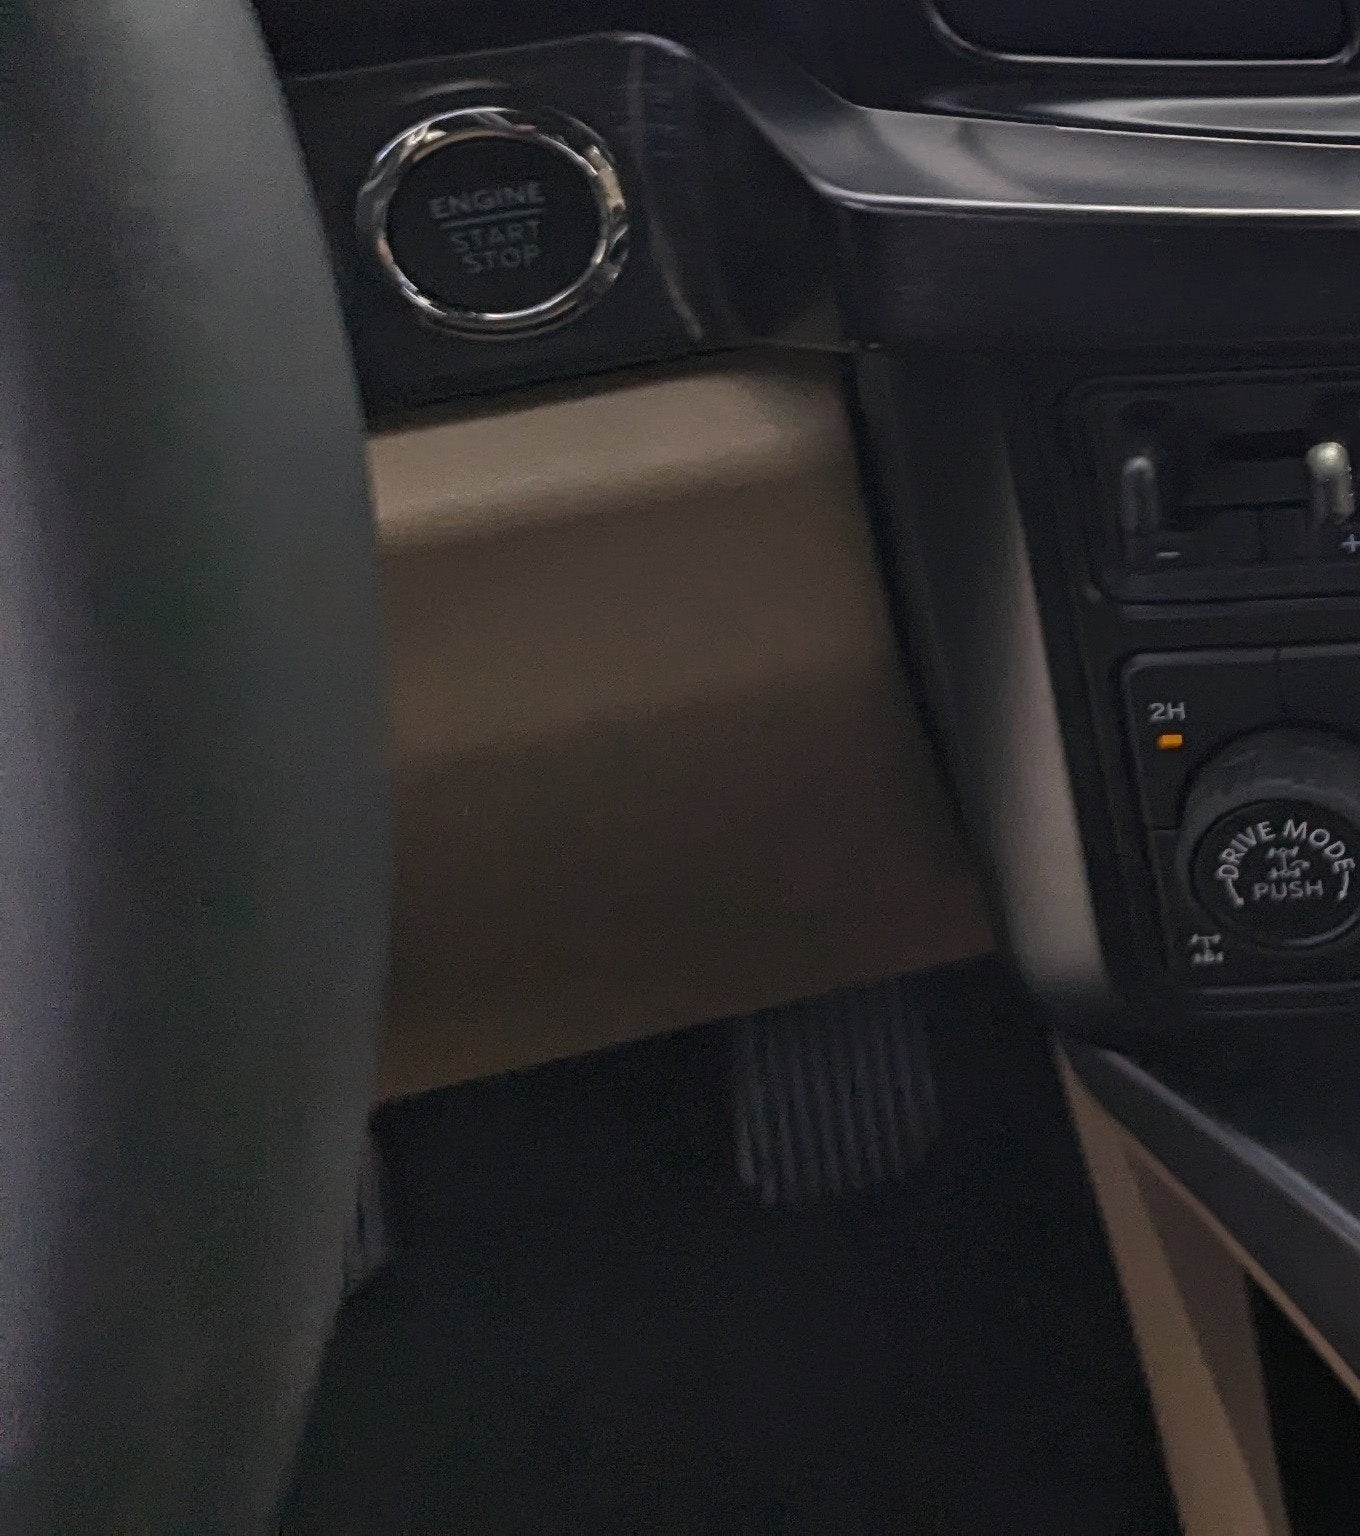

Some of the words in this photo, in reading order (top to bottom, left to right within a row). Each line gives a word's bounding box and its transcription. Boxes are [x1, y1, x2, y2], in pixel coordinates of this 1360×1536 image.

[428, 182, 545, 219] ENGINE
[450, 220, 541, 252] START
[462, 244, 540, 274] STOP
[1149, 702, 1186, 722] 2H
[1216, 820, 1276, 880] DRIVE
[1282, 818, 1355, 873] MODE
[1253, 881, 1324, 900] PUSH
